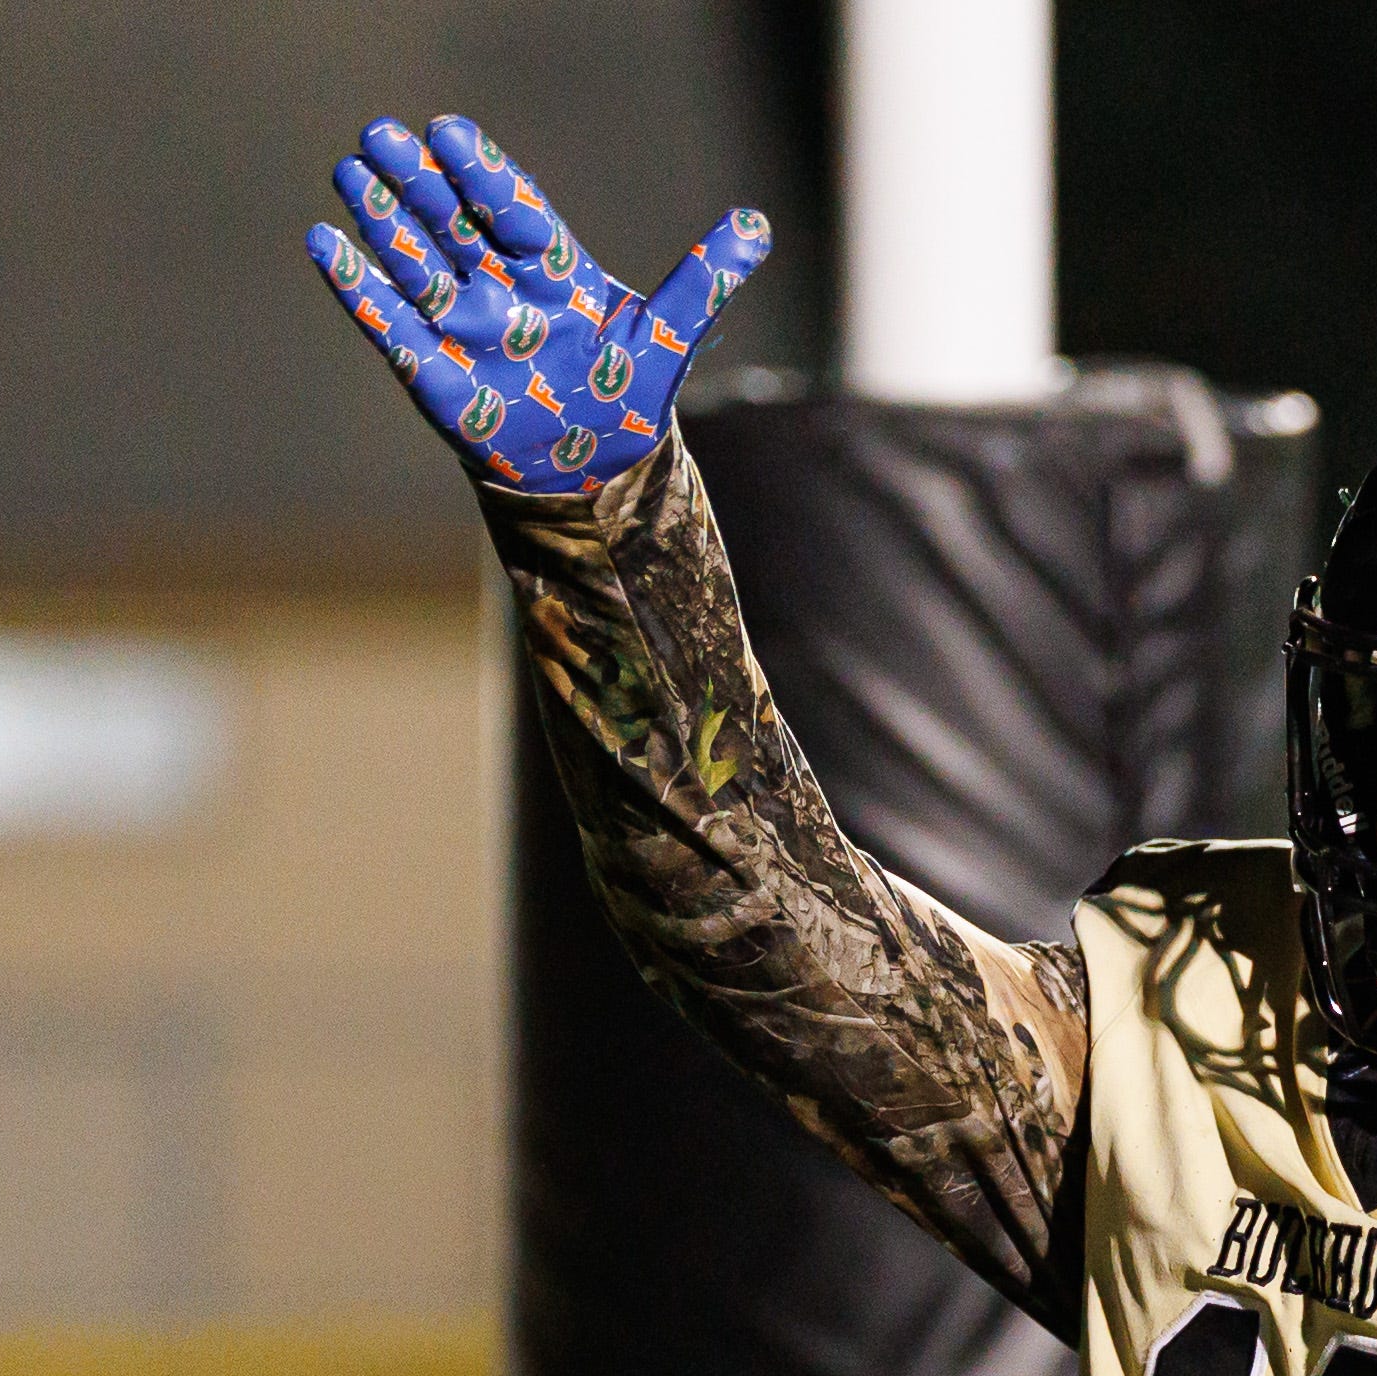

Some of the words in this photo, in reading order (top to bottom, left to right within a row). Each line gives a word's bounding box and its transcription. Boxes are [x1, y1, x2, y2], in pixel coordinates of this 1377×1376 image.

[513, 175, 545, 211] F
[390, 224, 428, 263] F
[478, 249, 516, 291] F
[355, 296, 392, 336] F
[567, 285, 607, 326] F
[437, 334, 476, 374] F
[649, 316, 690, 356] F
[525, 371, 565, 417] F
[620, 410, 657, 437] F
[487, 450, 524, 482] F
